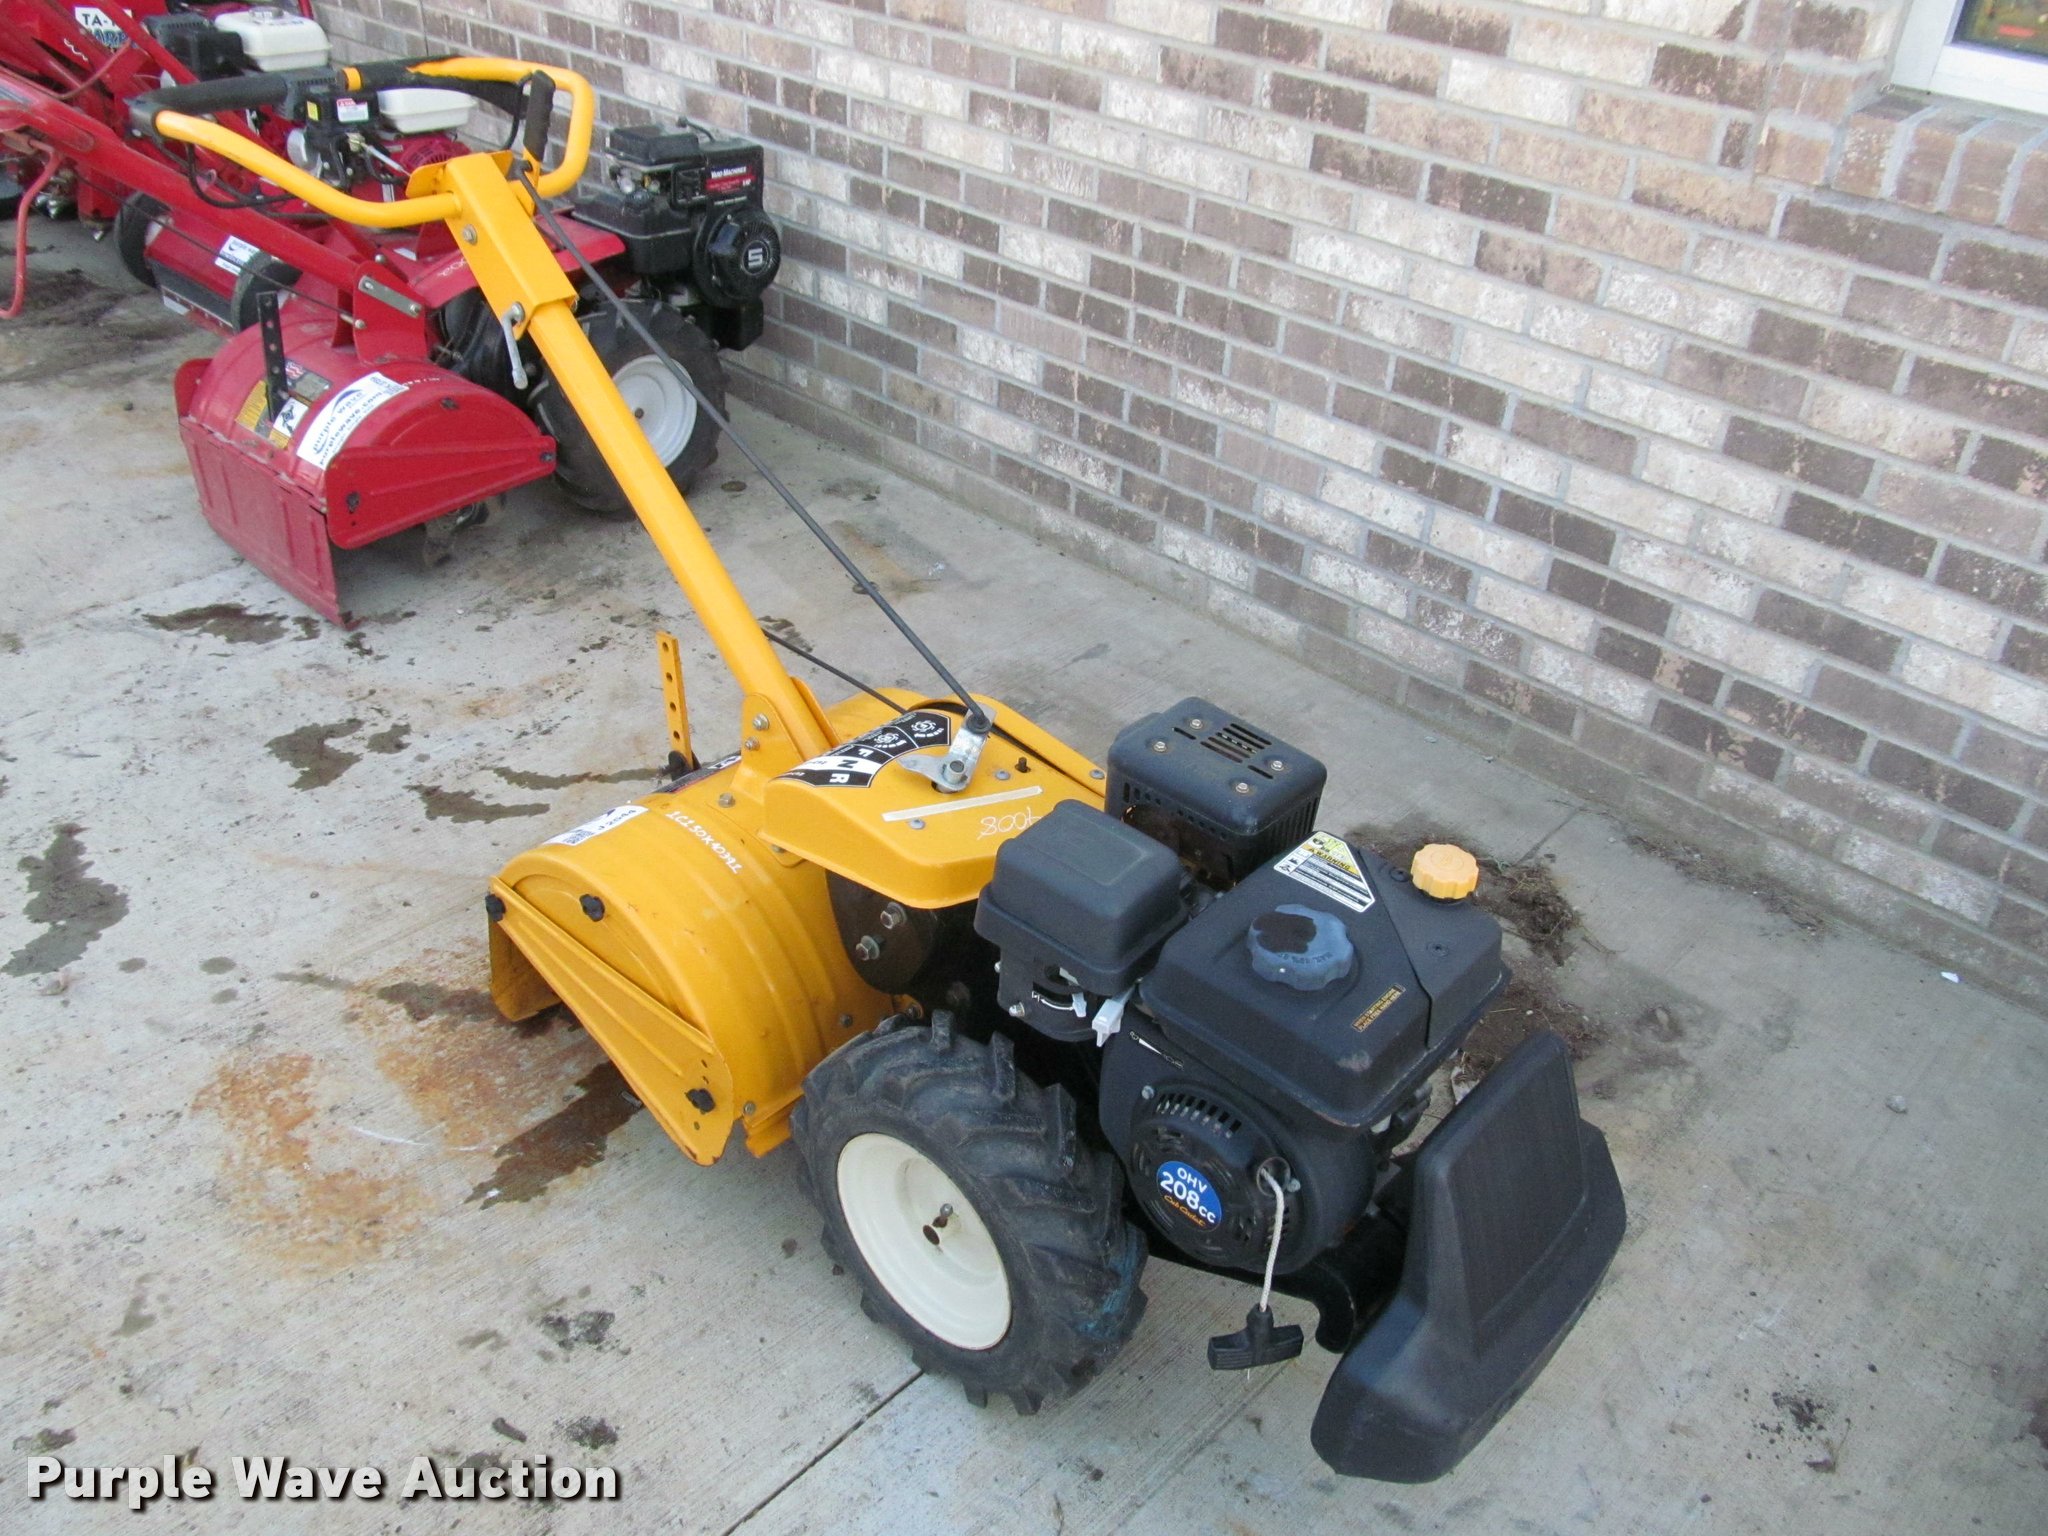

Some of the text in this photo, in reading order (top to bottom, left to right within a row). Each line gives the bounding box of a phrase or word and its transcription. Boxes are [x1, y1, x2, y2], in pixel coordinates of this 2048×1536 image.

[838, 759, 858, 768] N
[829, 773, 850, 784] R
[1316, 850, 1351, 871] WARNING
[1177, 1167, 1207, 1194] OHV
[1160, 1171, 1216, 1223] 208cc
